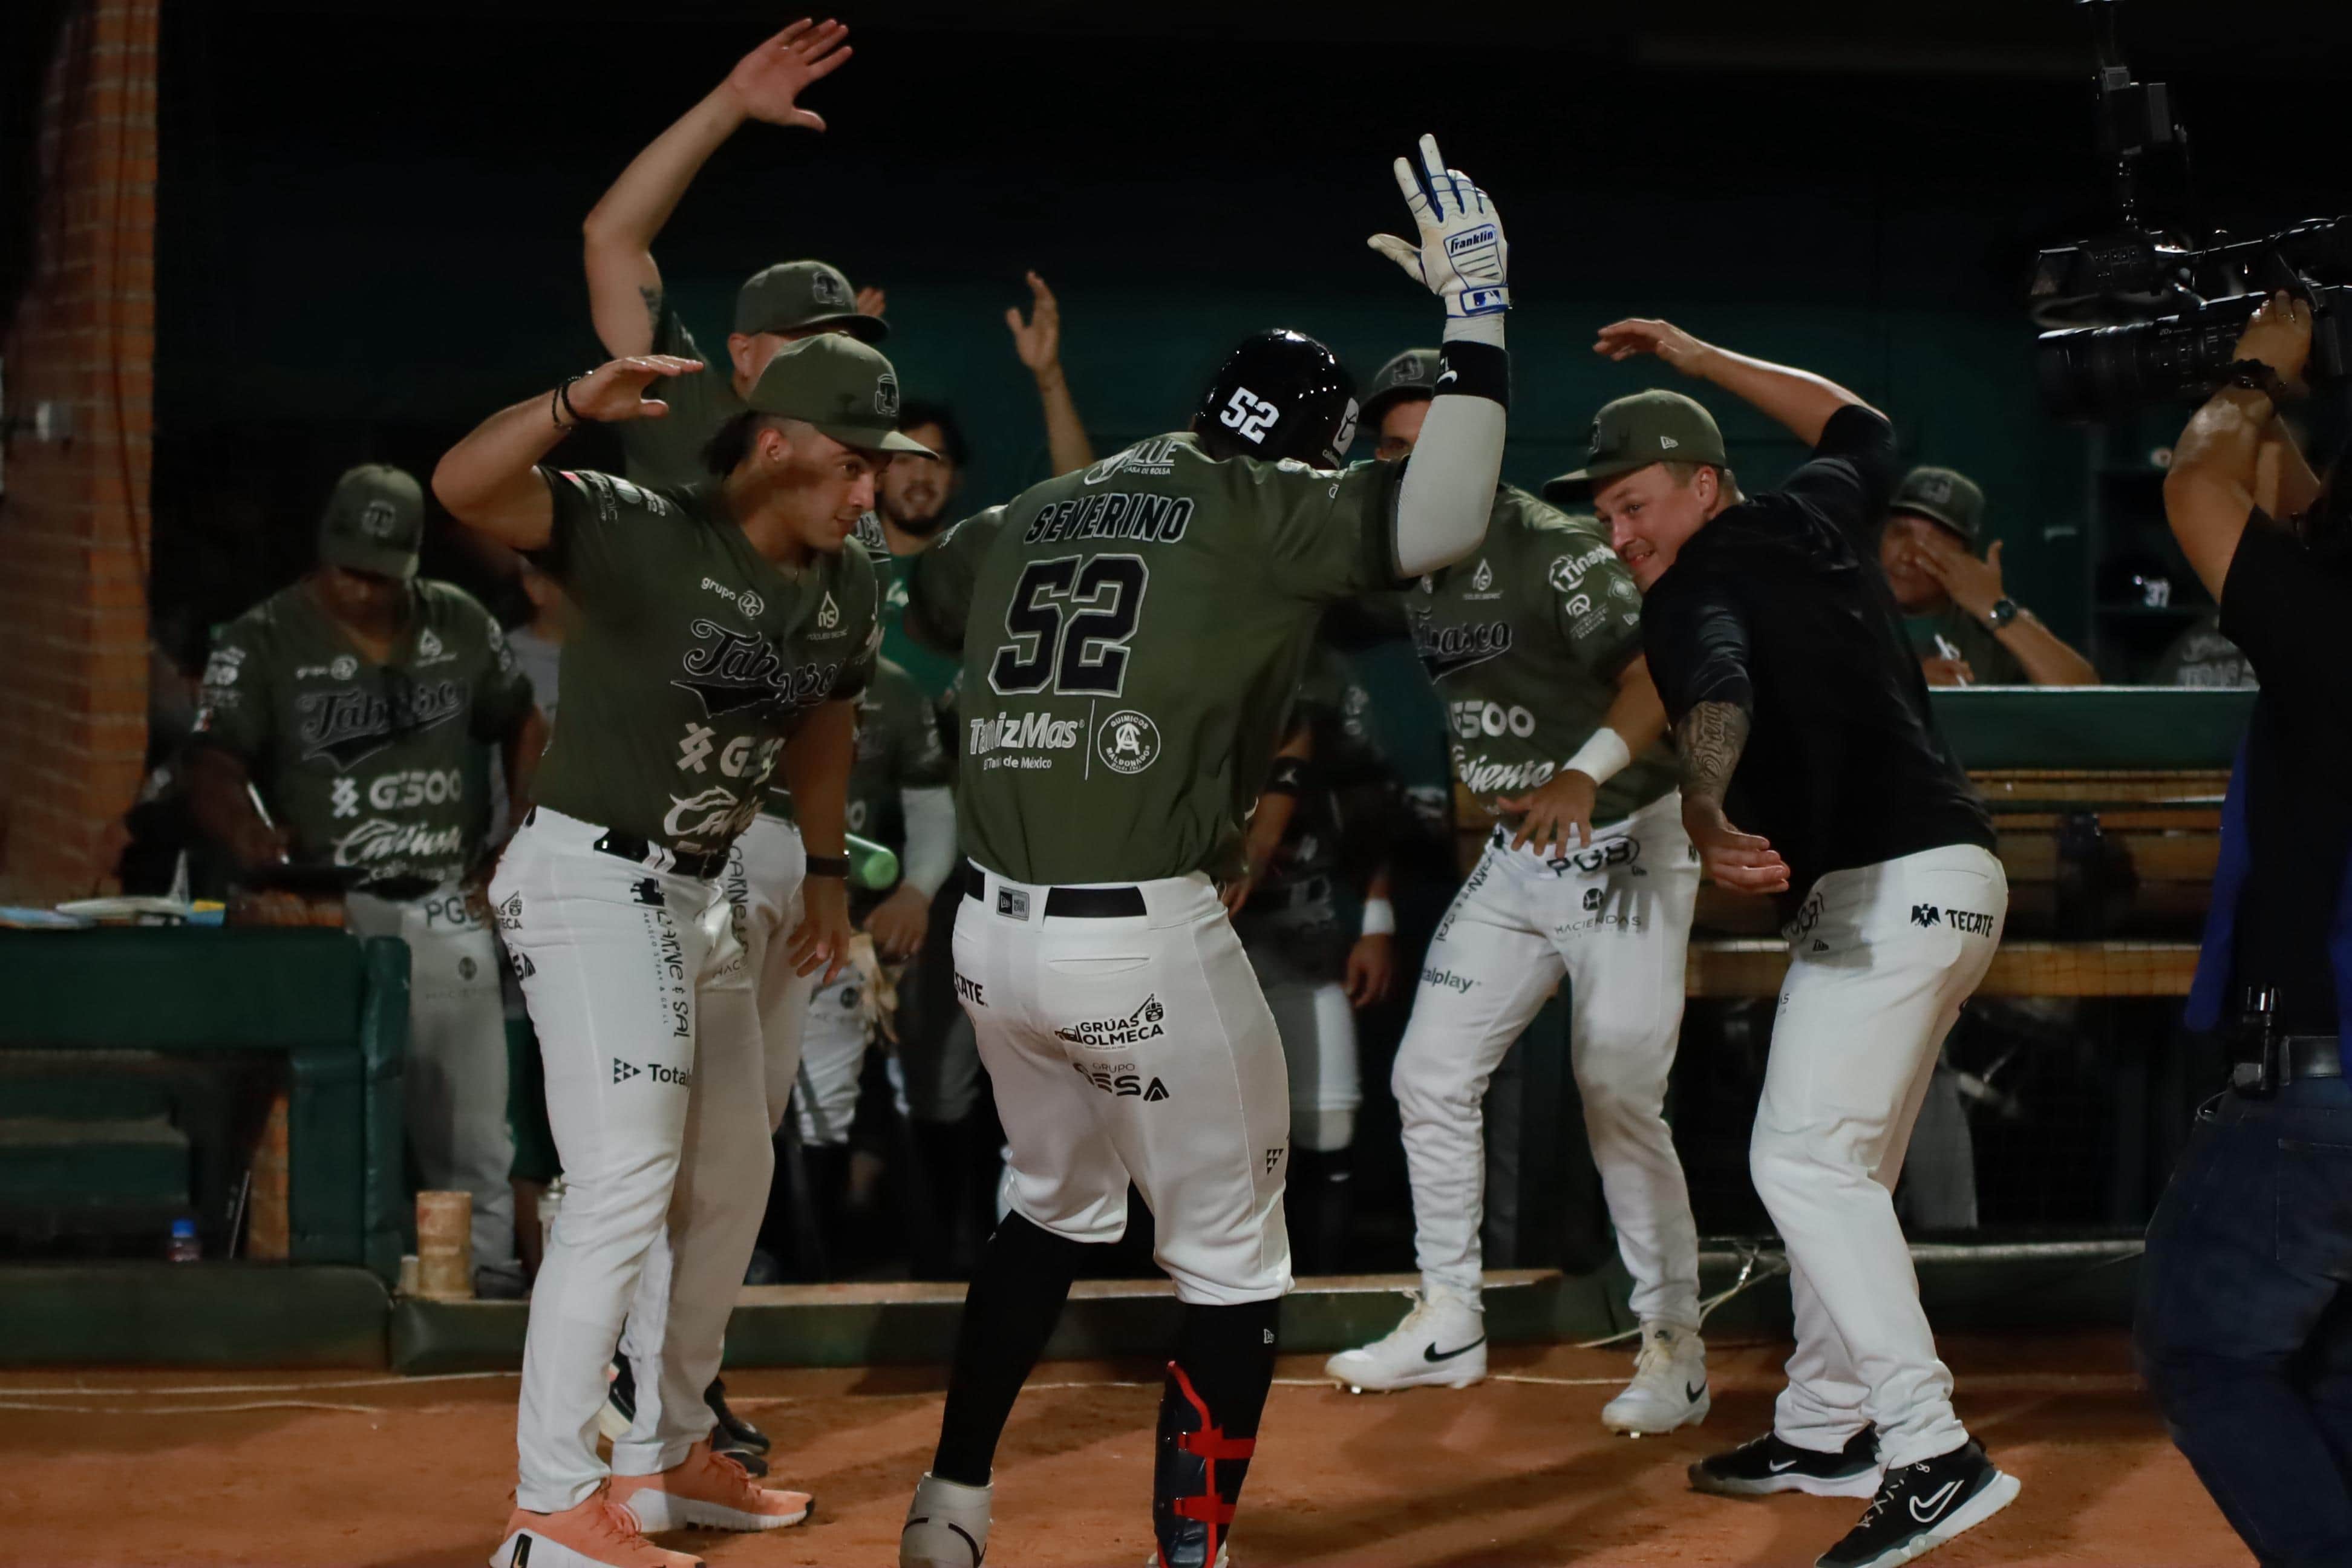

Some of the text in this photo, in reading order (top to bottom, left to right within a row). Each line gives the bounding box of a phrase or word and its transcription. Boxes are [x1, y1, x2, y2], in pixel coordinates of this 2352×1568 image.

[1220, 386, 1280, 445] 52
[1024, 492, 1195, 543] SEVERINO
[701, 577, 736, 601] grupo
[988, 553, 1149, 699] 52
[1110, 715, 1149, 730] QUIMICOS
[1003, 755, 1019, 768] de
[1021, 756, 1053, 769] México
[1555, 915, 1641, 935] HACIENDAS
[1945, 909, 1994, 938] TECATE
[673, 1001, 691, 1038] SAL
[1080, 1018, 1140, 1033] GRÚAS
[1083, 1024, 1164, 1045] OLMECA
[1093, 1062, 1135, 1073] GRUPO
